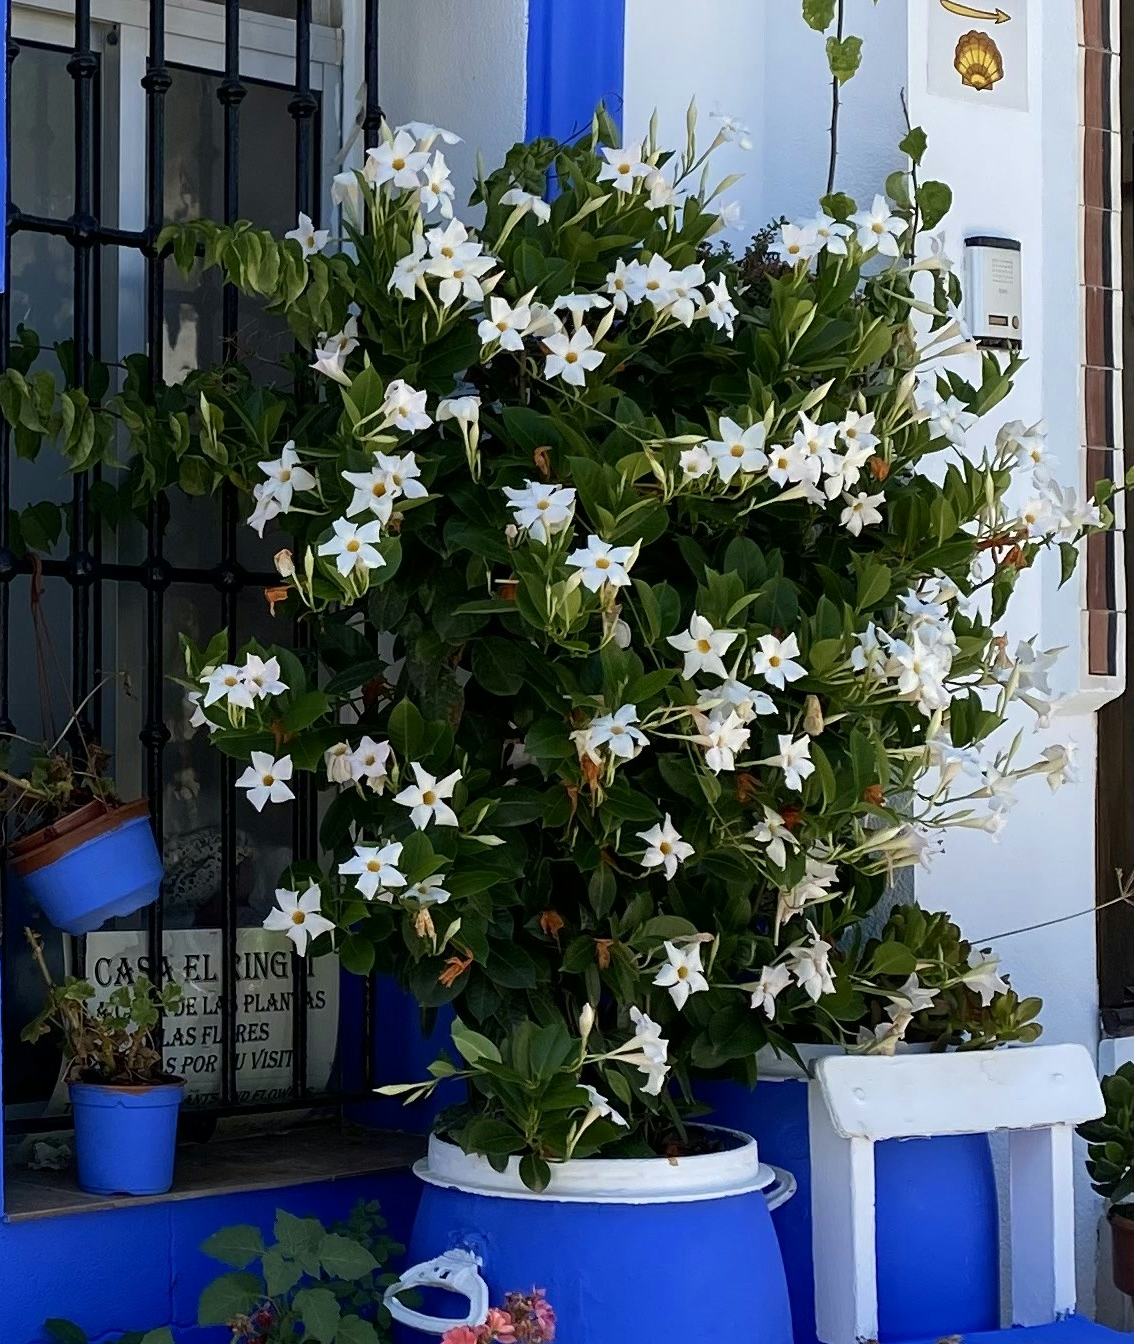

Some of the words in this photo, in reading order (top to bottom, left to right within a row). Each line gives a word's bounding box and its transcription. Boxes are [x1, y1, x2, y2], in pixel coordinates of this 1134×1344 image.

[95, 956, 177, 987] CASA
[183, 953, 218, 982] EL
[201, 1022, 270, 1045] FLRES
[180, 1054, 218, 1074] POR
